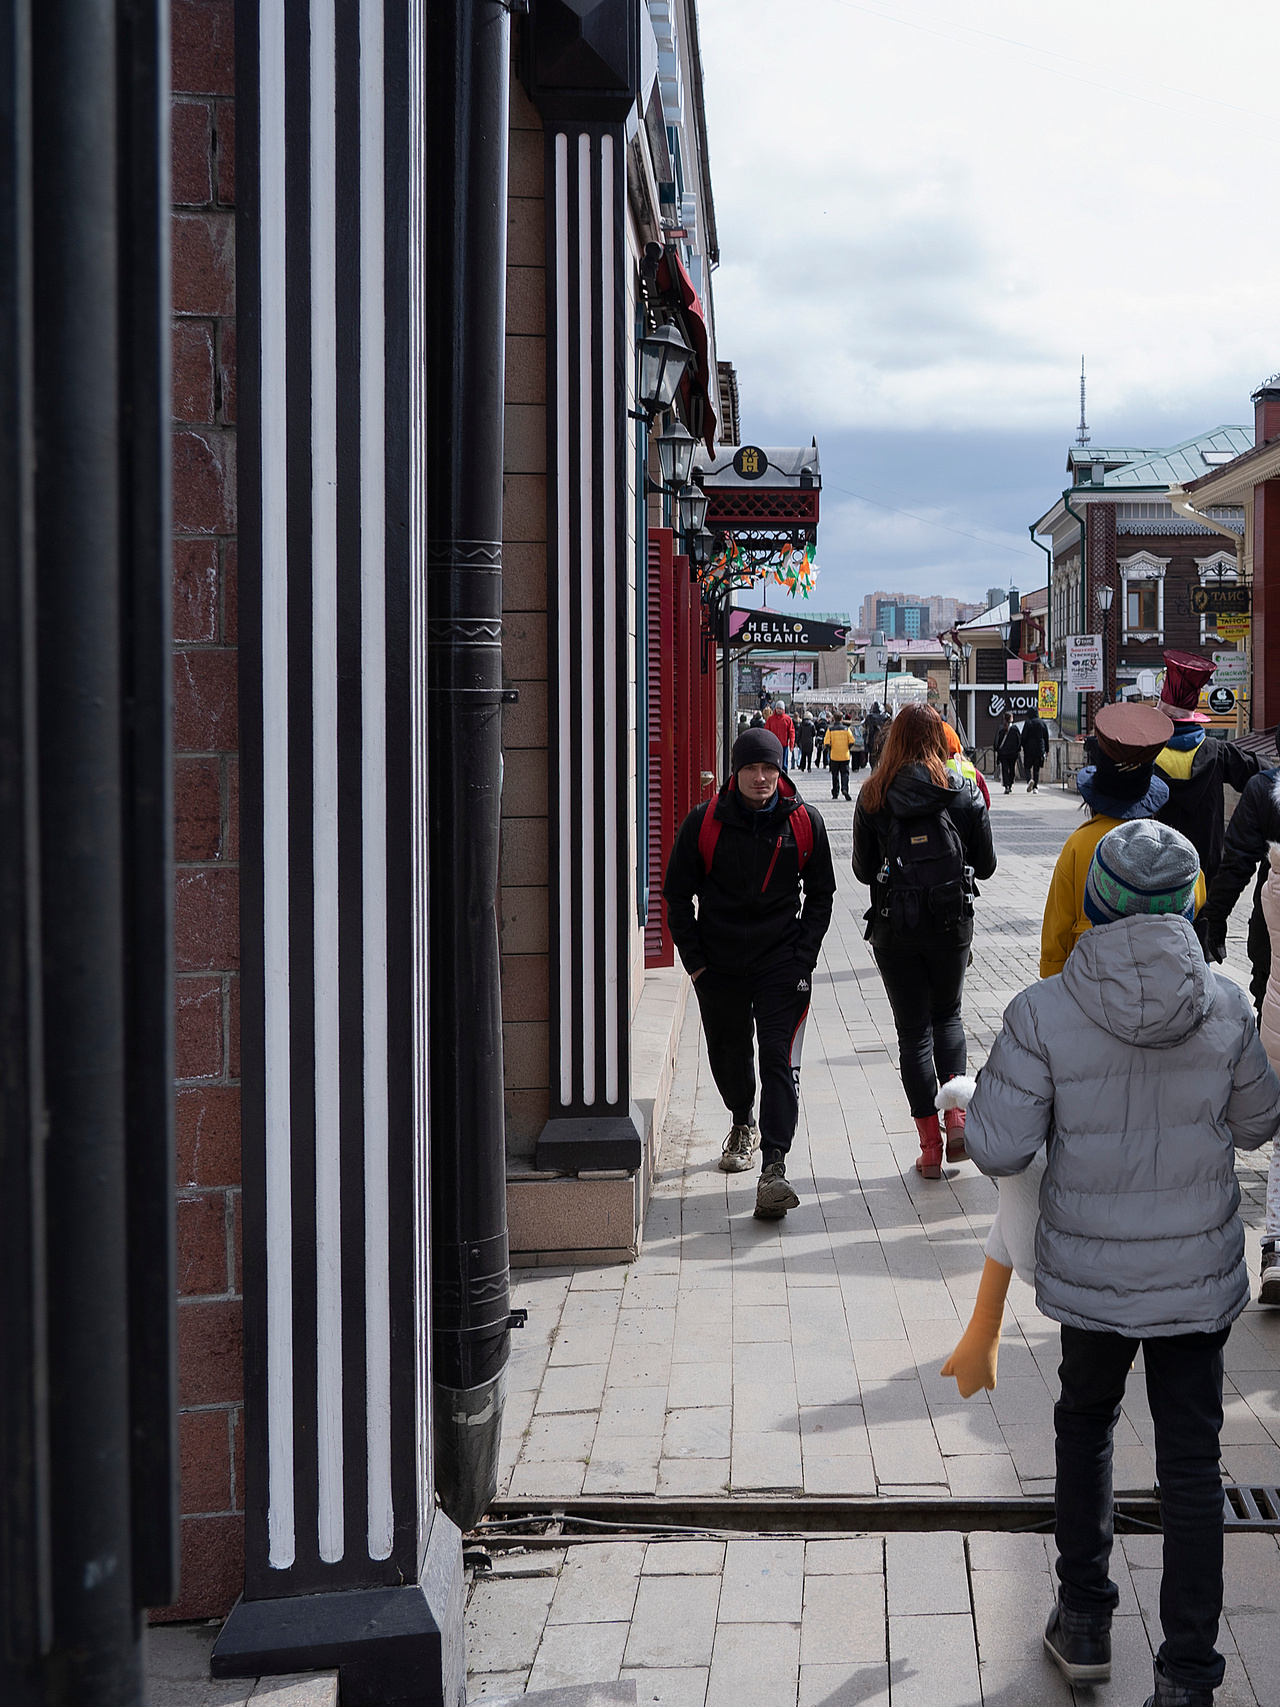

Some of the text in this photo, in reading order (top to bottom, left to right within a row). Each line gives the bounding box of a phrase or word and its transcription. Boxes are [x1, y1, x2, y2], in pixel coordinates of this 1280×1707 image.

[1211, 591, 1244, 601] ТАИС
[748, 622, 803, 633] HELLO
[742, 633, 809, 643] ORGANIC
